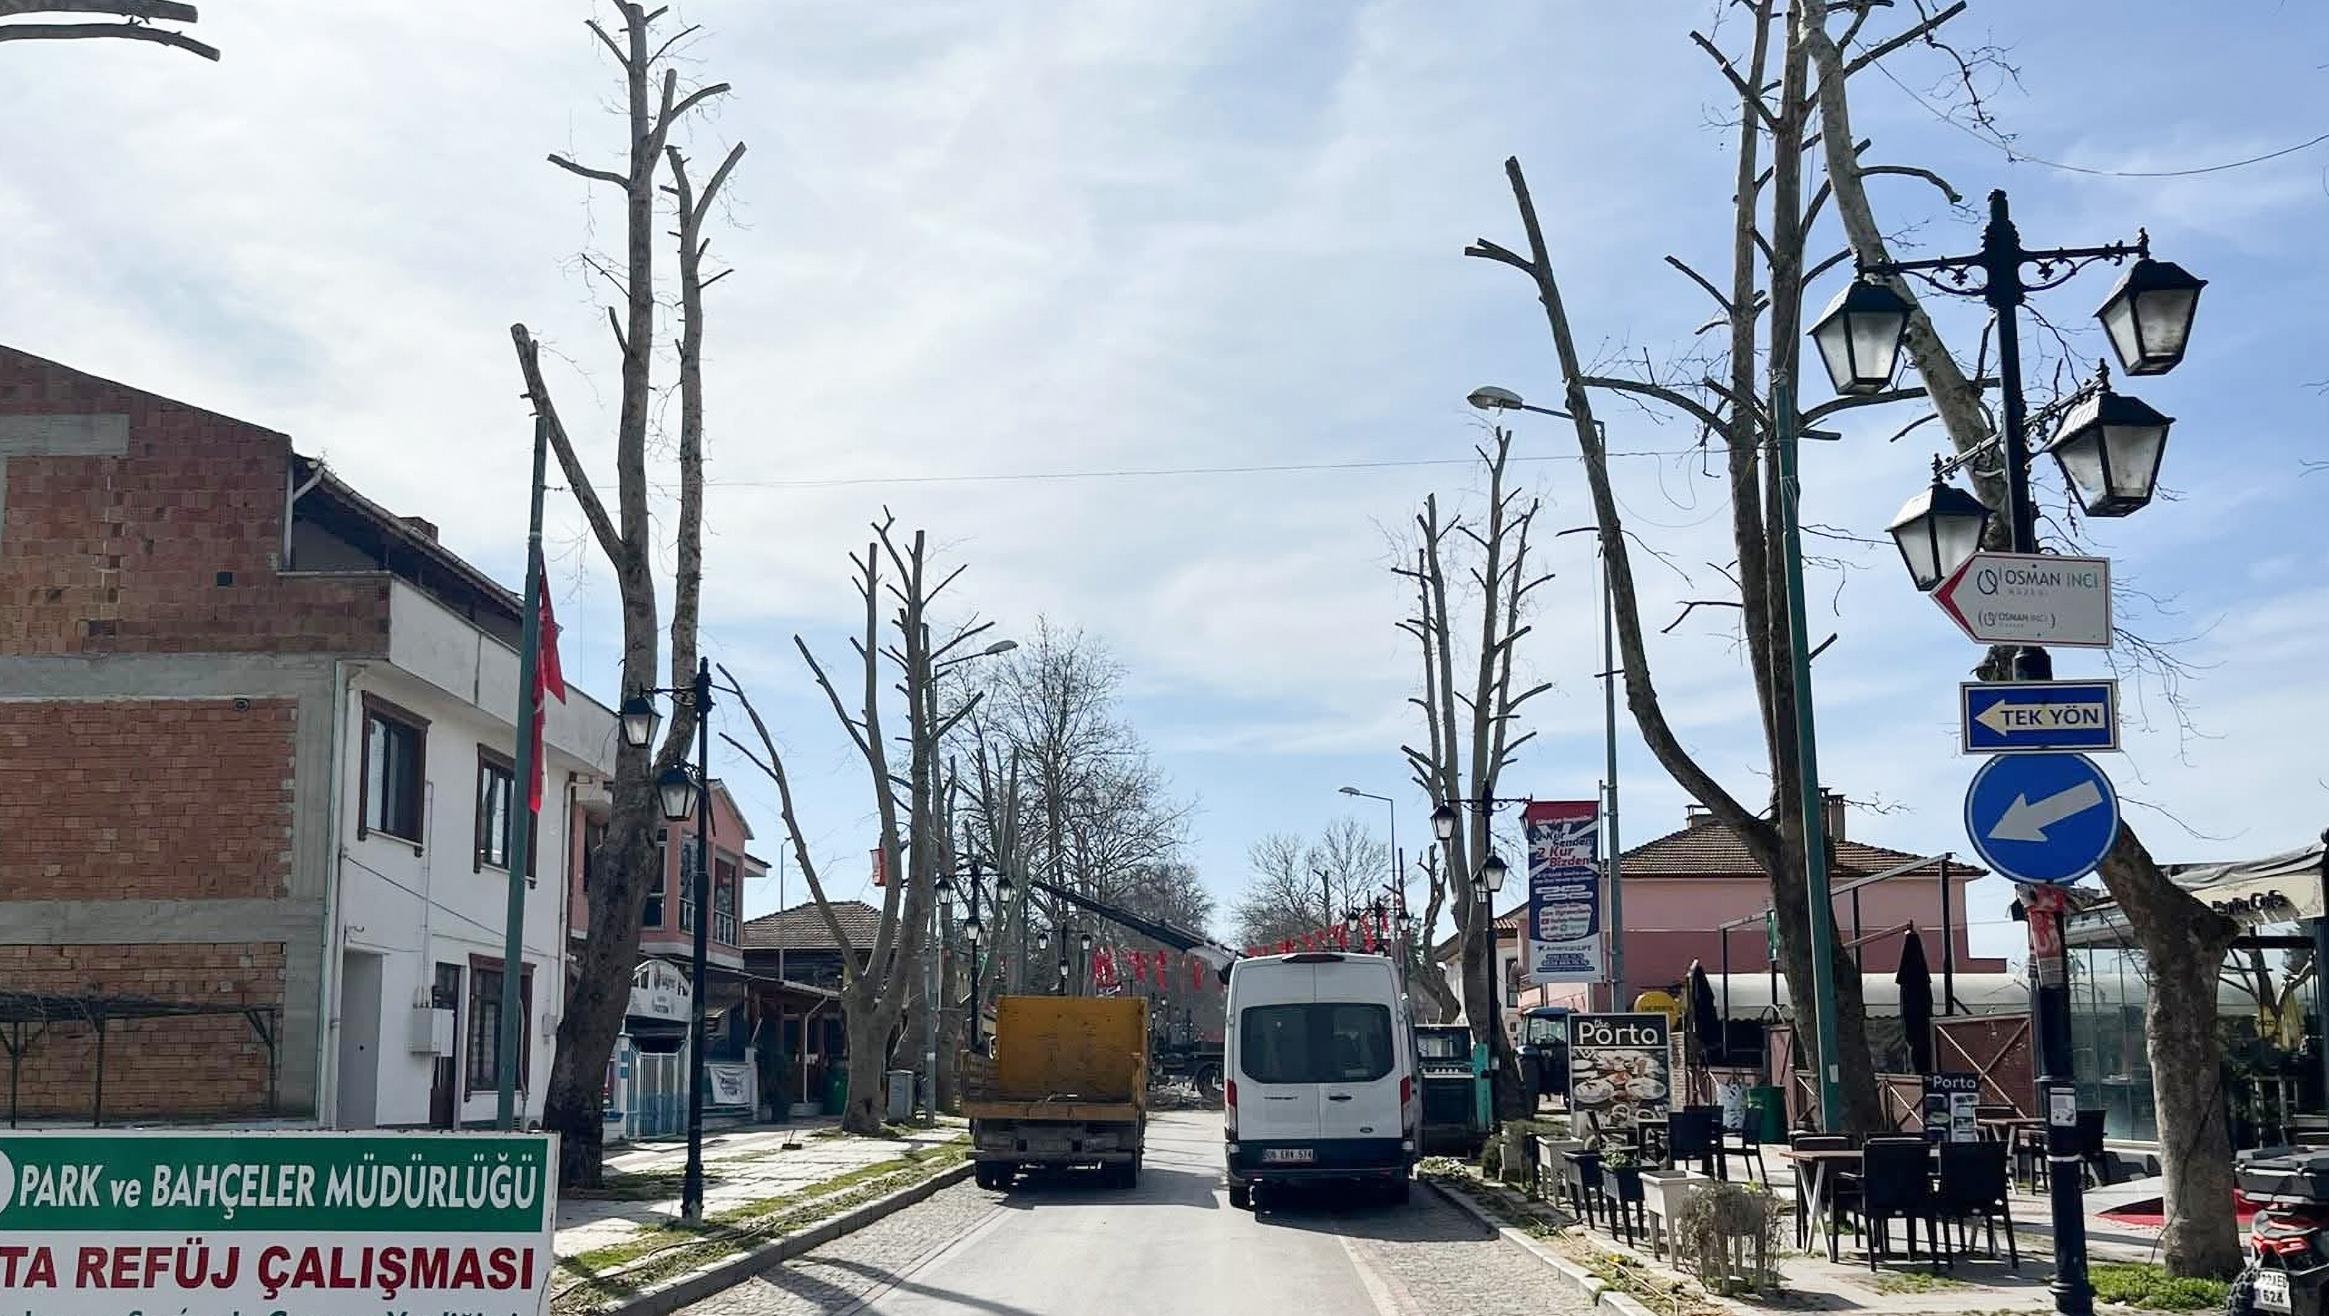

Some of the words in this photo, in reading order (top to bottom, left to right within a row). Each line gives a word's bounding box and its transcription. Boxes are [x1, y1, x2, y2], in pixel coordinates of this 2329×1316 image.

[2005, 570, 2060, 586] OSMAN
[2000, 709, 2042, 726] TEK
[2050, 705, 2099, 724] YÖN
[1553, 837, 1593, 847] Senden
[1536, 847, 1546, 858] 2
[1550, 846, 1575, 857] Kur
[1550, 856, 1590, 867] Bizden
[1594, 1018, 1611, 1029] the
[1578, 1021, 1658, 1045] Porta
[1933, 1075, 1976, 1089] Porta
[19, 1165, 103, 1207] PARK
[110, 1178, 142, 1208] ve
[151, 1163, 316, 1220] BAHÇELER
[324, 1153, 537, 1209] MÜDÜRLÜĞÜ
[75, 1237, 240, 1289] REFÜJ
[257, 1245, 534, 1300] ÇALIŞMASI
